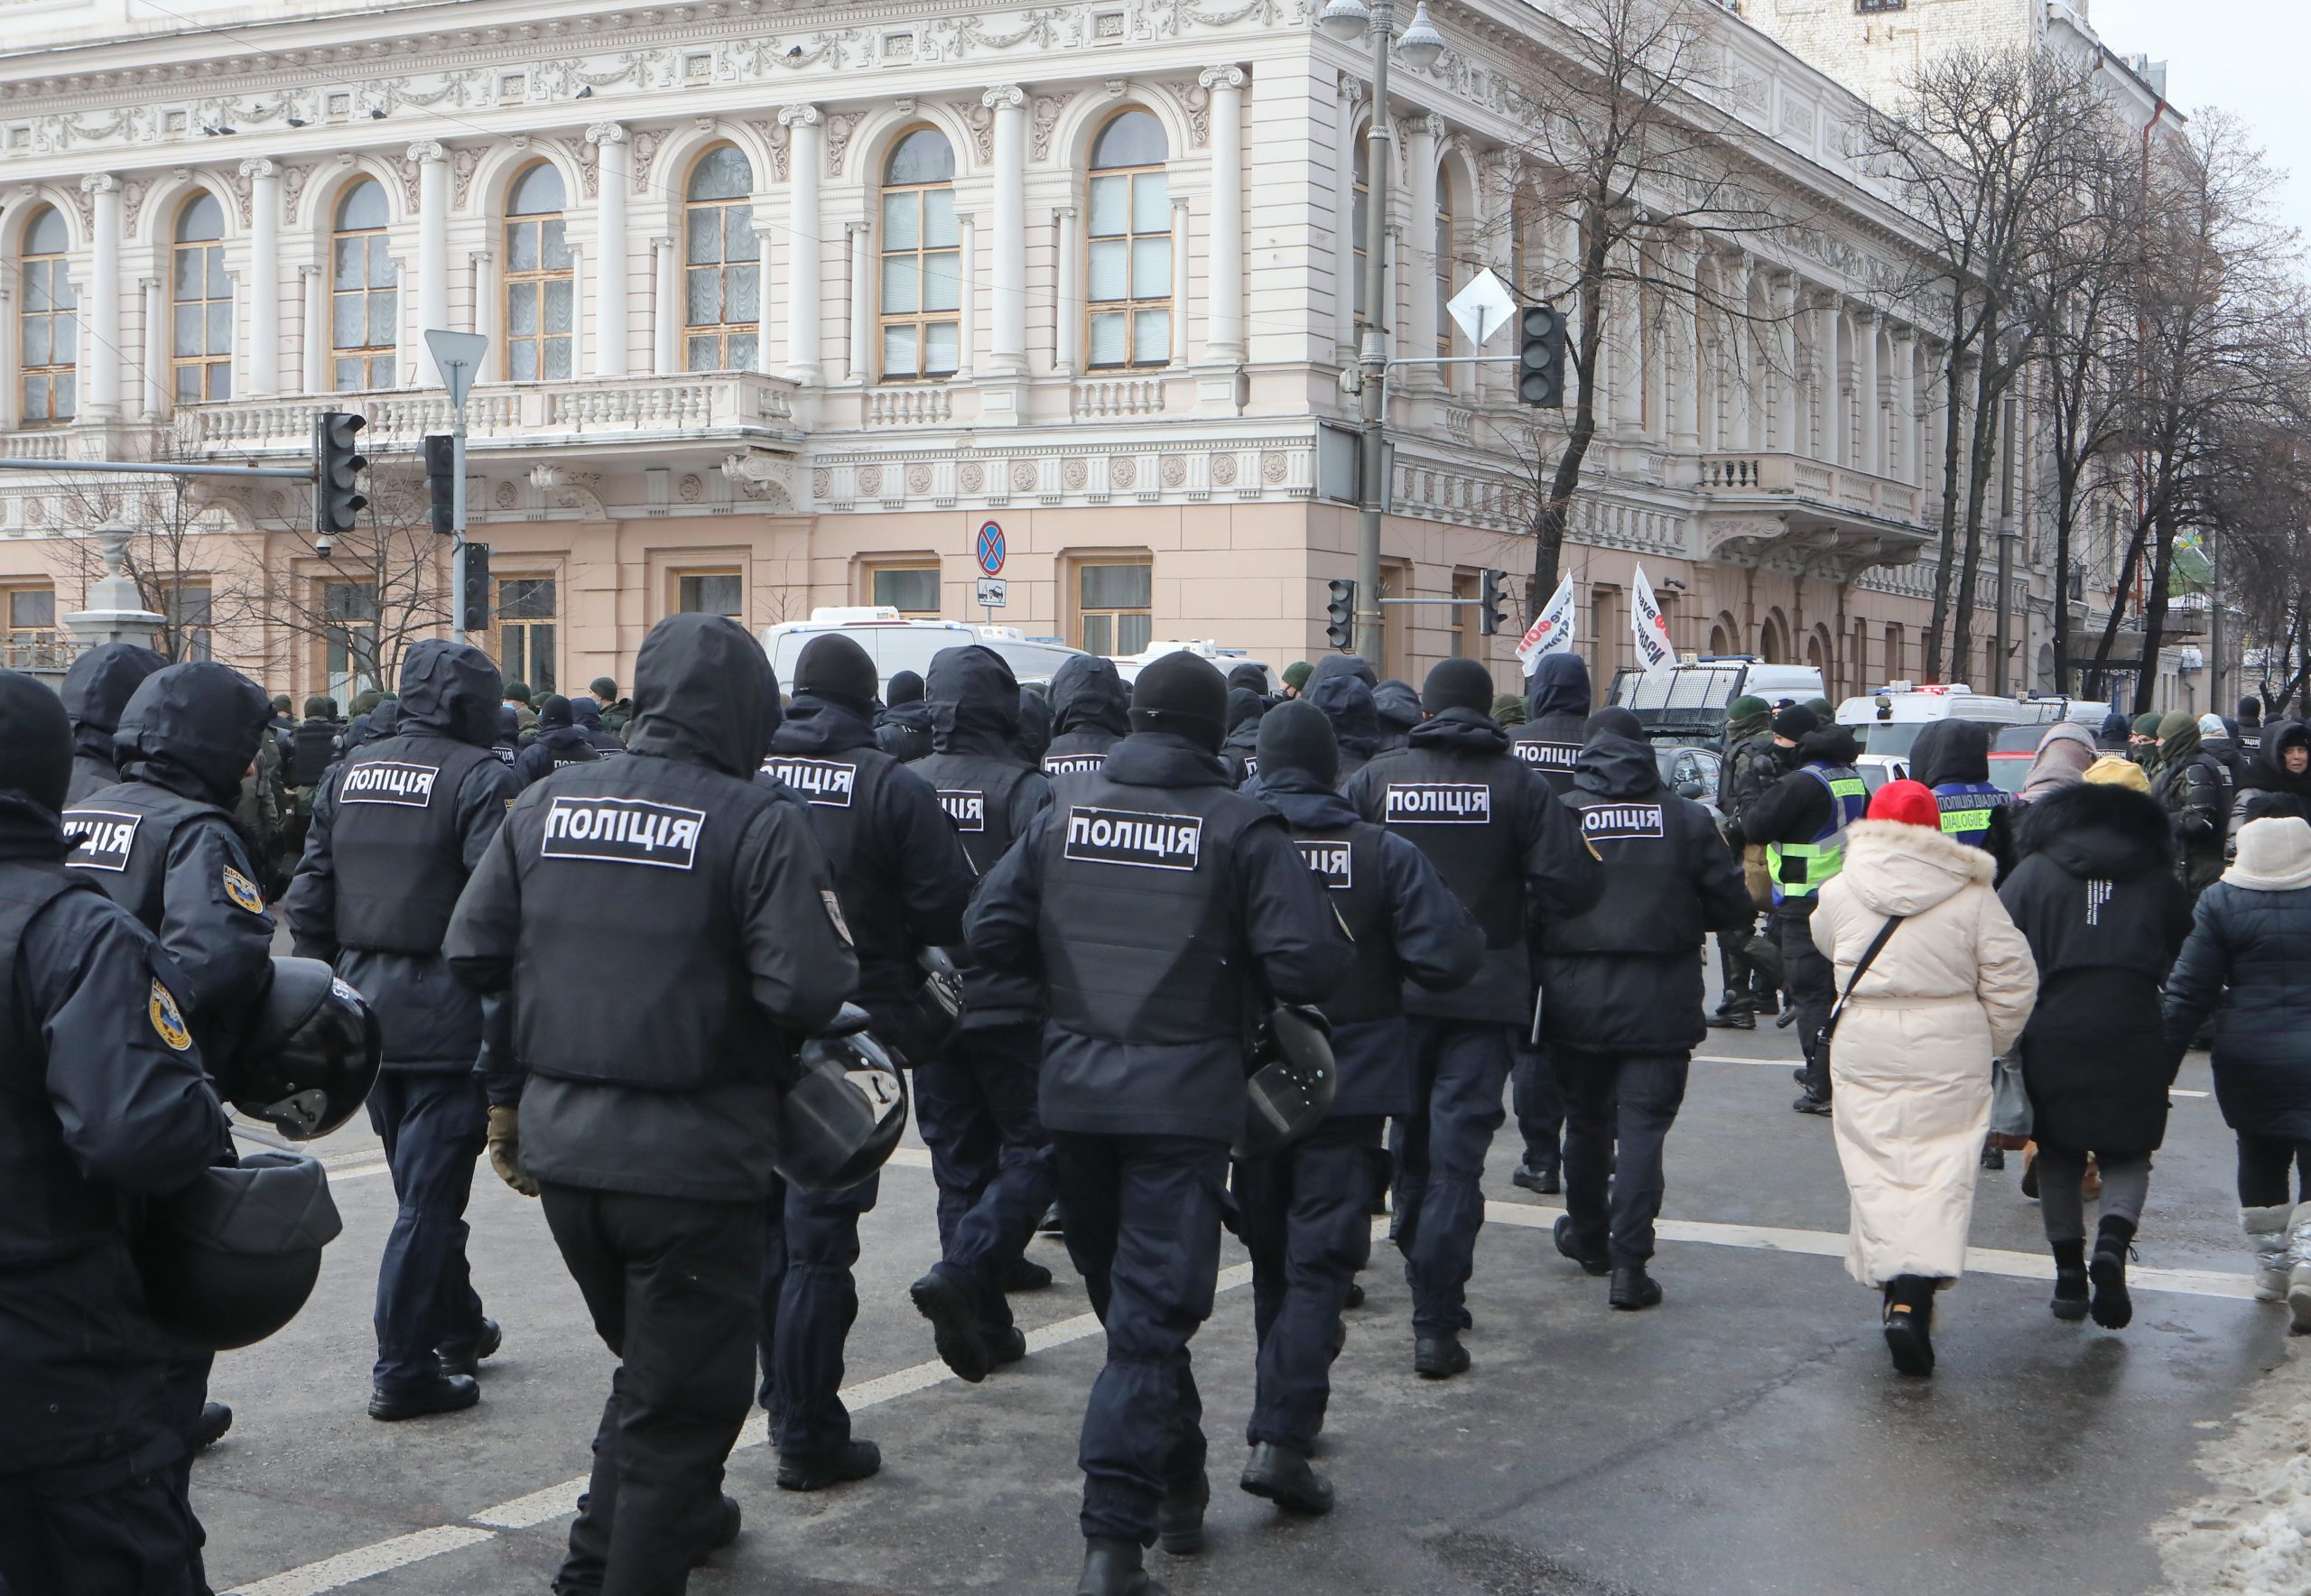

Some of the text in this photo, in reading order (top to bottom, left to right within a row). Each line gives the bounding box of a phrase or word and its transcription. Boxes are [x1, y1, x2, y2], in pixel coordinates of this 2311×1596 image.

[345, 768, 433, 795] ПОЛІЦІЯ
[938, 798, 981, 819] ЦІЯ
[1388, 791, 1488, 815] ПОЛІЦІЯ
[1938, 794, 1974, 810] ПОЛІЦІЯ
[547, 808, 699, 851] ПОЛІЦІЯ
[1582, 810, 1661, 830] ОЛІЦІЯ
[1943, 812, 1984, 830] DIALOGUE
[1069, 817, 1197, 858] ПОЛІЦІЯ
